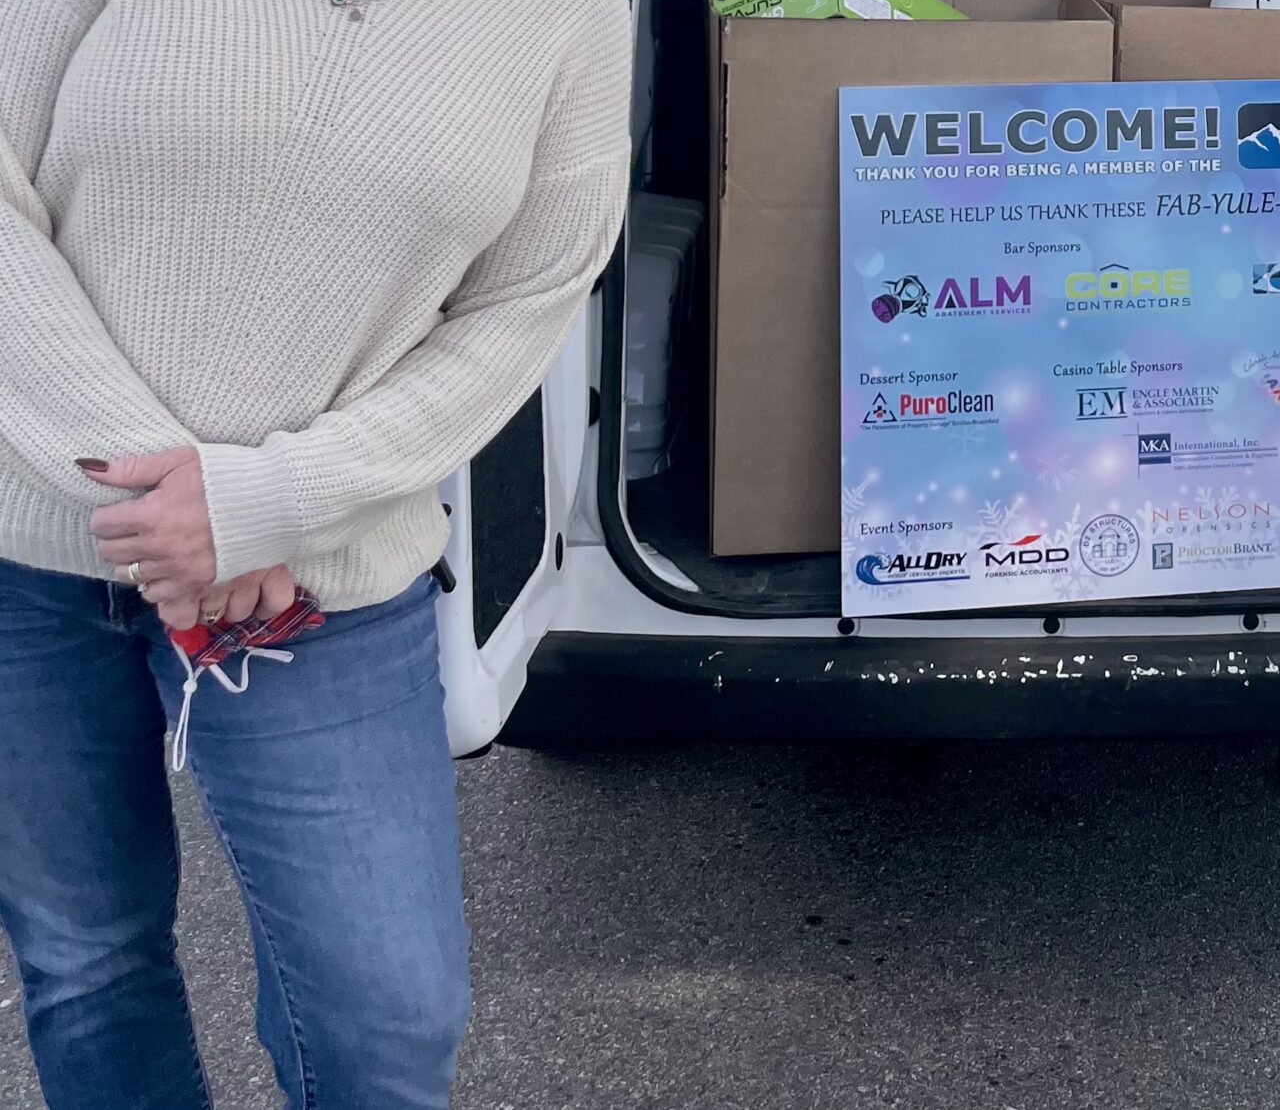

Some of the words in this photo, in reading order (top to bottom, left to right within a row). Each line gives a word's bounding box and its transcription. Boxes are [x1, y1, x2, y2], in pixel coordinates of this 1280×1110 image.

[850, 106, 1221, 158] WELCOME!
[855, 166, 917, 181] THANK
[922, 165, 959, 179] YOU
[965, 164, 1000, 178] FOR
[1006, 163, 1062, 177] BEING
[1067, 162, 1079, 176] A
[1084, 160, 1155, 175] MEMBER
[1161, 160, 1183, 173] OF
[1188, 158, 1221, 172] THE
[880, 208, 945, 225] PLEASE
[951, 206, 995, 223] HELP
[1000, 205, 1023, 222] US
[1027, 203, 1089, 220] THANK
[1093, 201, 1146, 218] THESE
[1003, 242, 1024, 254] Bar
[1027, 241, 1081, 257] Sponsors
[1065, 268, 1192, 299] CORE
[934, 275, 1031, 309] ALM
[1066, 297, 1192, 311] CONTRACTORS
[1053, 364, 1094, 376] Casino
[1096, 362, 1127, 375] Table
[1130, 361, 1183, 377] Sponsors
[860, 371, 905, 385] Dessert
[908, 370, 958, 387] Sponsor
[1133, 389, 1171, 399] ENGLE
[1172, 386, 1219, 397] MARTIN
[900, 390, 994, 416] PuroClean
[1077, 391, 1127, 417] EM
[1132, 400, 1141, 409] &
[1144, 397, 1214, 408] ASSOCIATES
[1140, 440, 1170, 453] MKA
[1174, 438, 1240, 450] International,
[1243, 438, 1261, 447] Inc.
[1152, 503, 1270, 522] NELSON
[860, 523, 894, 535] Event
[898, 521, 953, 536] Sponsors
[1152, 521, 1271, 535] FORENSICS
[985, 548, 1070, 567] MDD
[1020, 568, 1069, 576] ACCOUNTANTS
